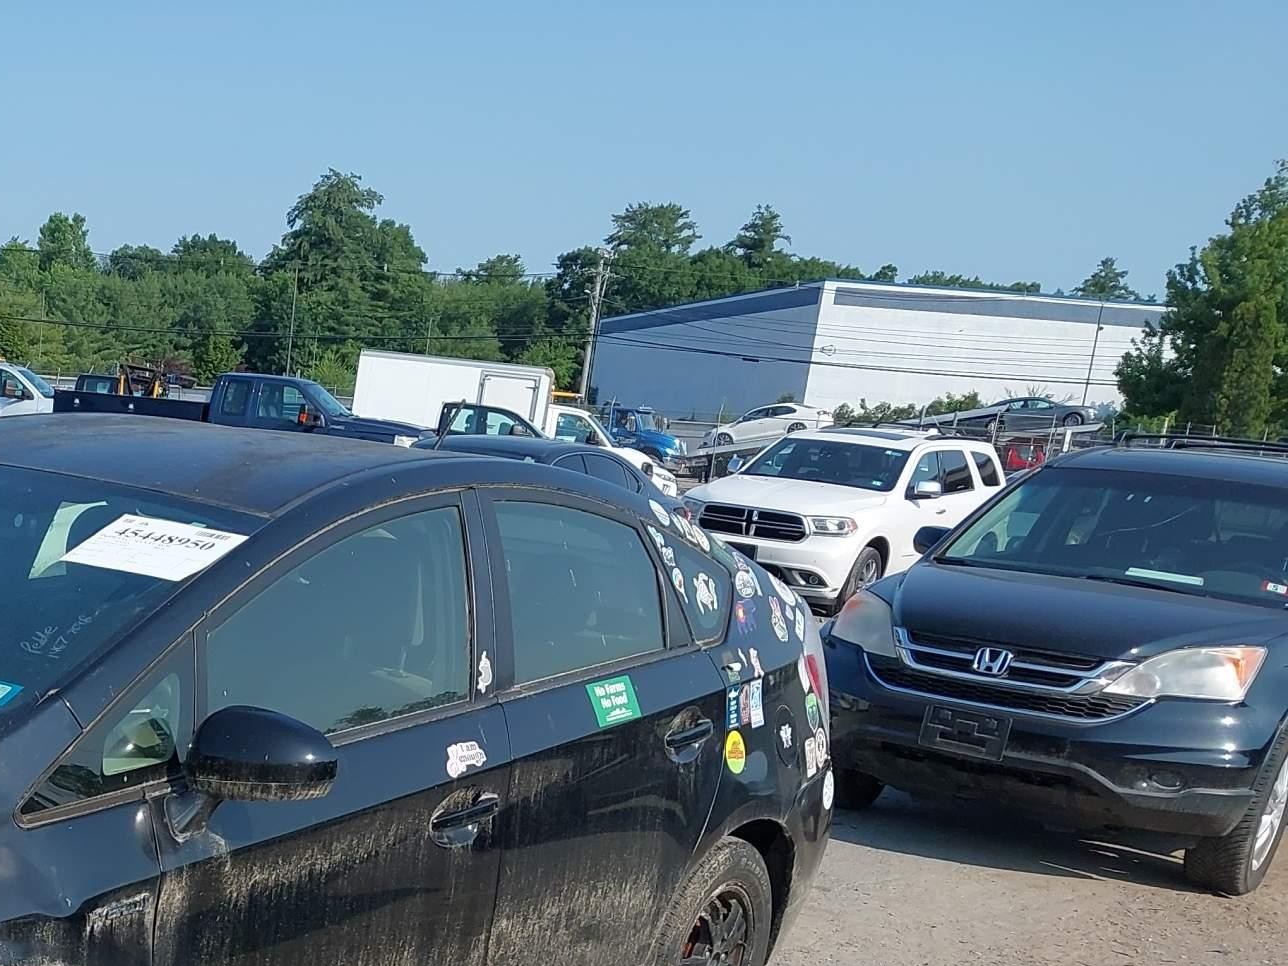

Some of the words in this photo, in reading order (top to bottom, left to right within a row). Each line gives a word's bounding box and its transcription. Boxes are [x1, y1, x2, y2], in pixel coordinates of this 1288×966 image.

[114, 527, 216, 551] 45448950
[593, 686, 607, 697] No
[604, 682, 626, 695] Farms
[601, 697, 613, 709] No
[611, 692, 629, 706] Food
